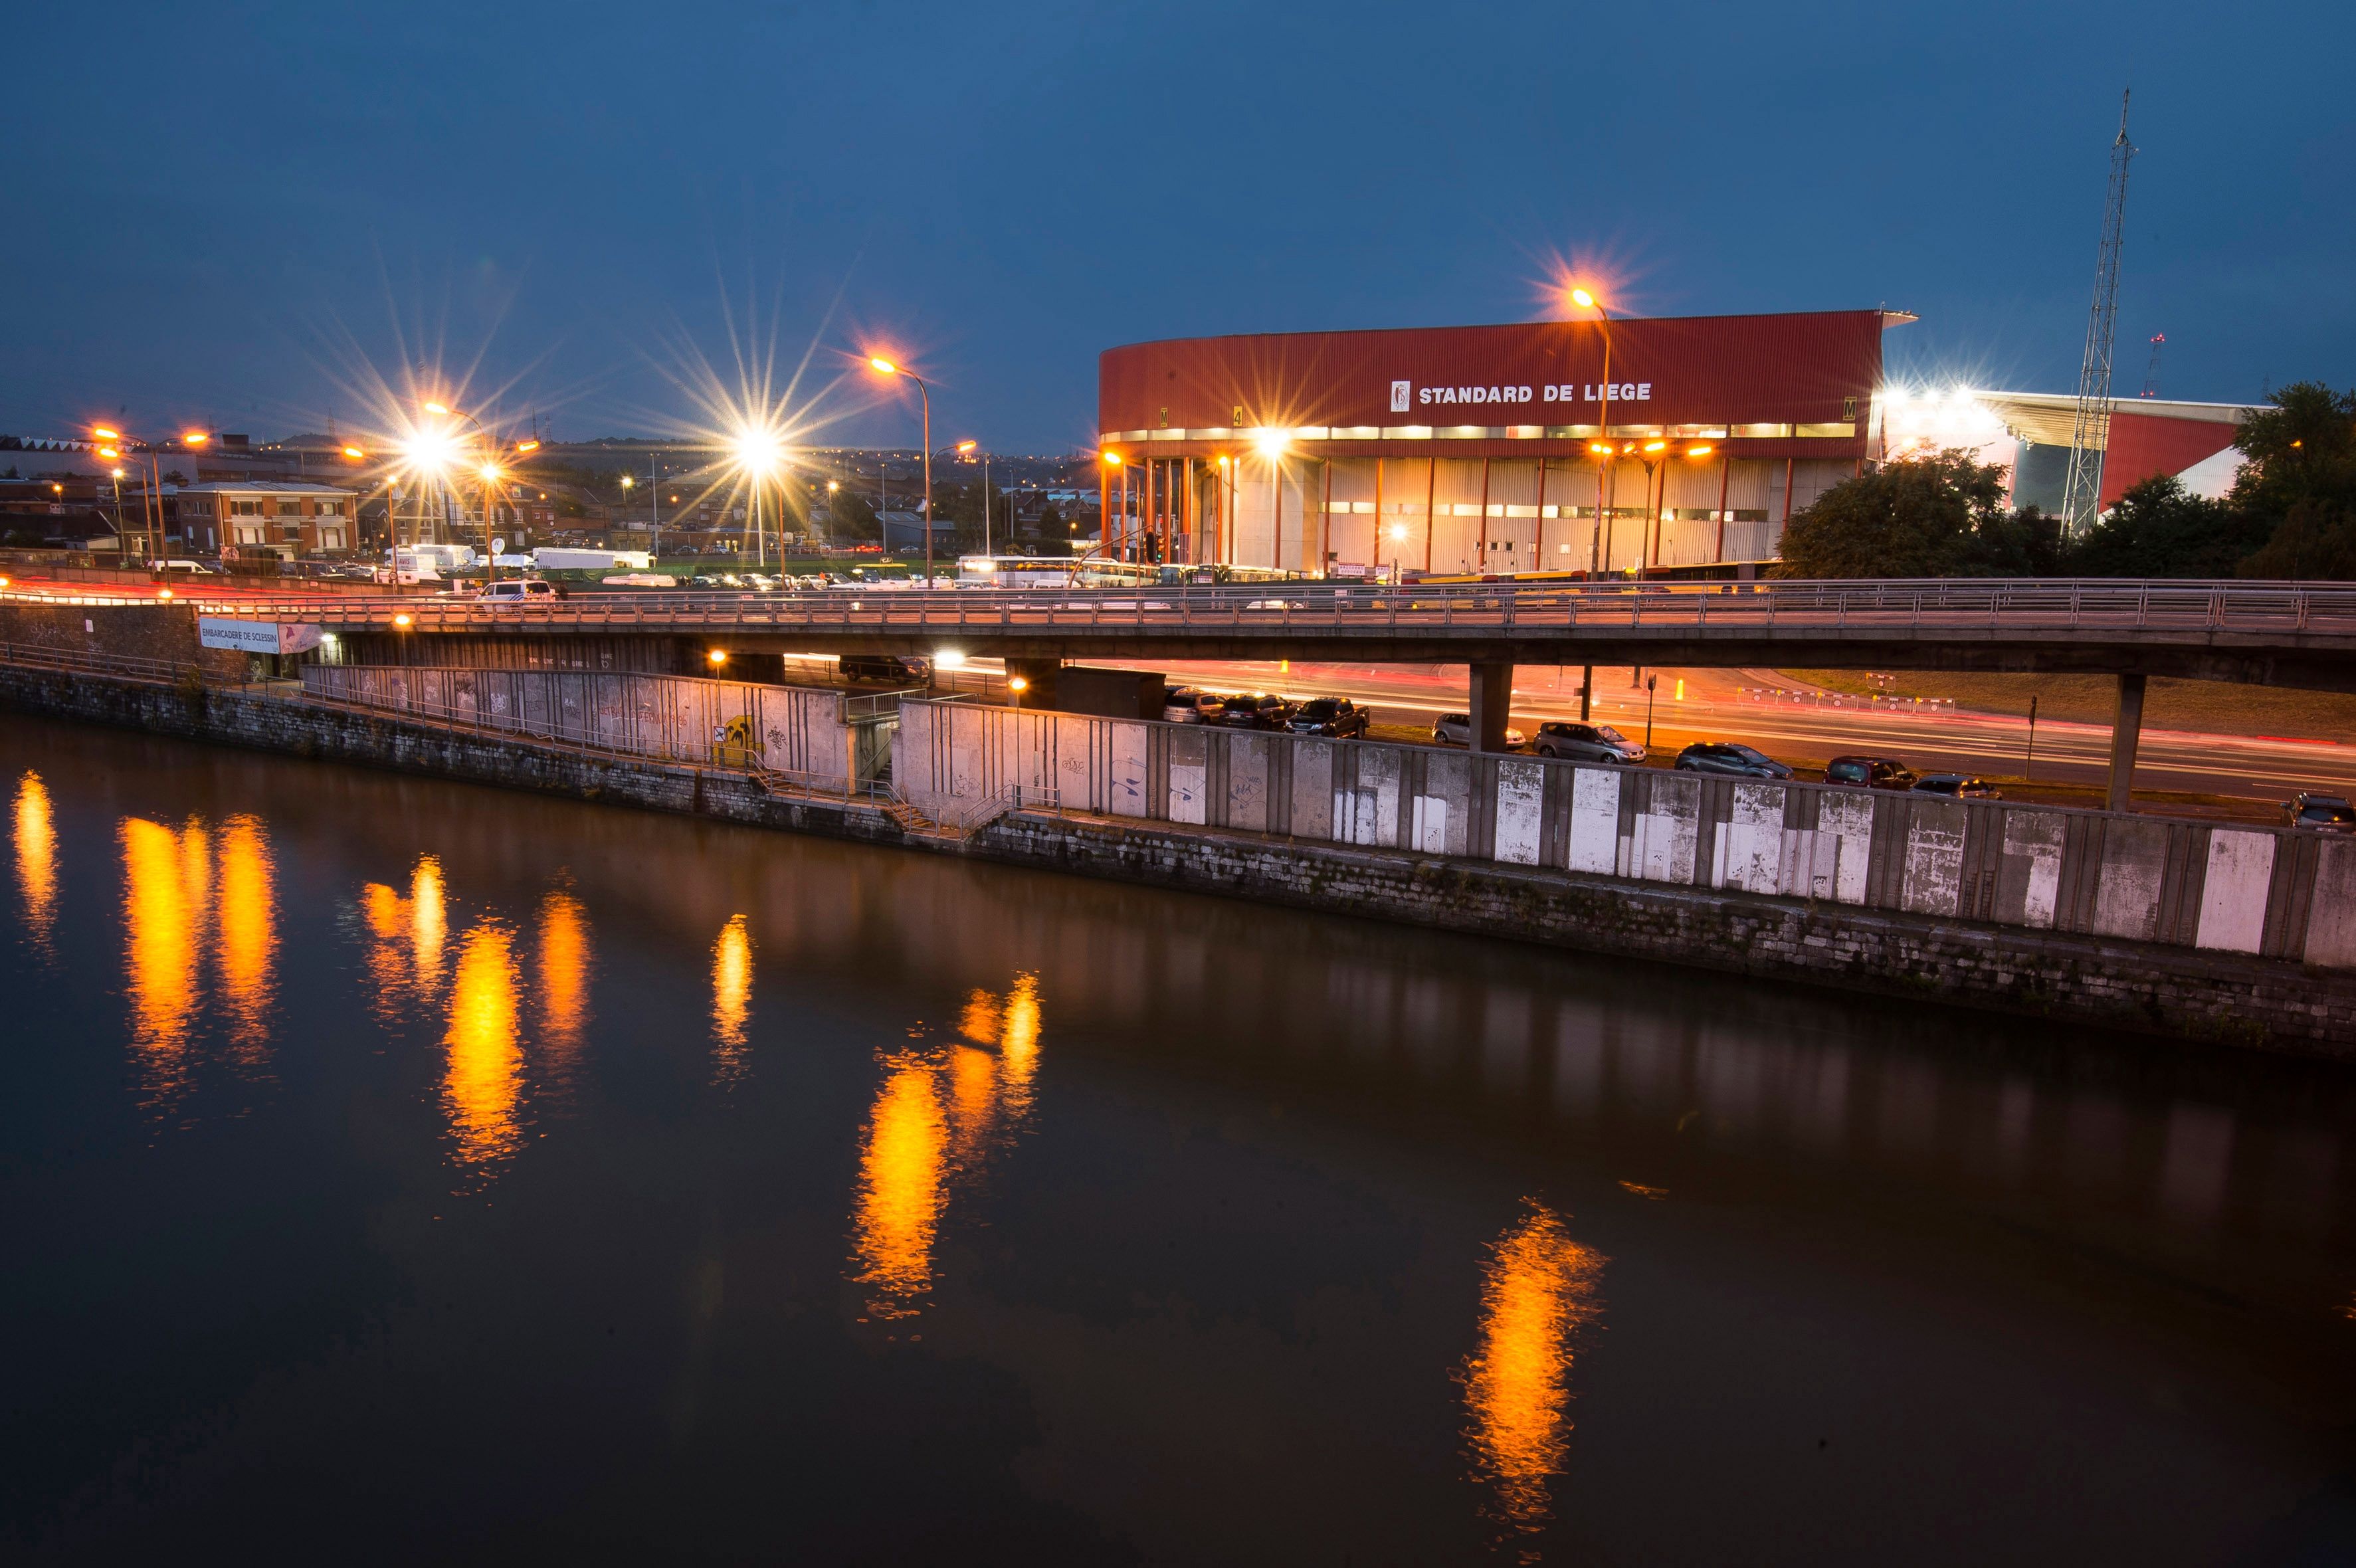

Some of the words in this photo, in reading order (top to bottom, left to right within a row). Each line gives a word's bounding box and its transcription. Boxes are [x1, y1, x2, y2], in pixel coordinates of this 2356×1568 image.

[1419, 386, 1532, 404] STANDARD
[1544, 385, 1573, 401] DE
[1585, 383, 1651, 401] LIEGE
[1844, 401, 1856, 416] M
[1234, 411, 1241, 425] 4
[202, 629, 242, 639] EMBARCADERE
[252, 633, 276, 642] SCLESSIN
